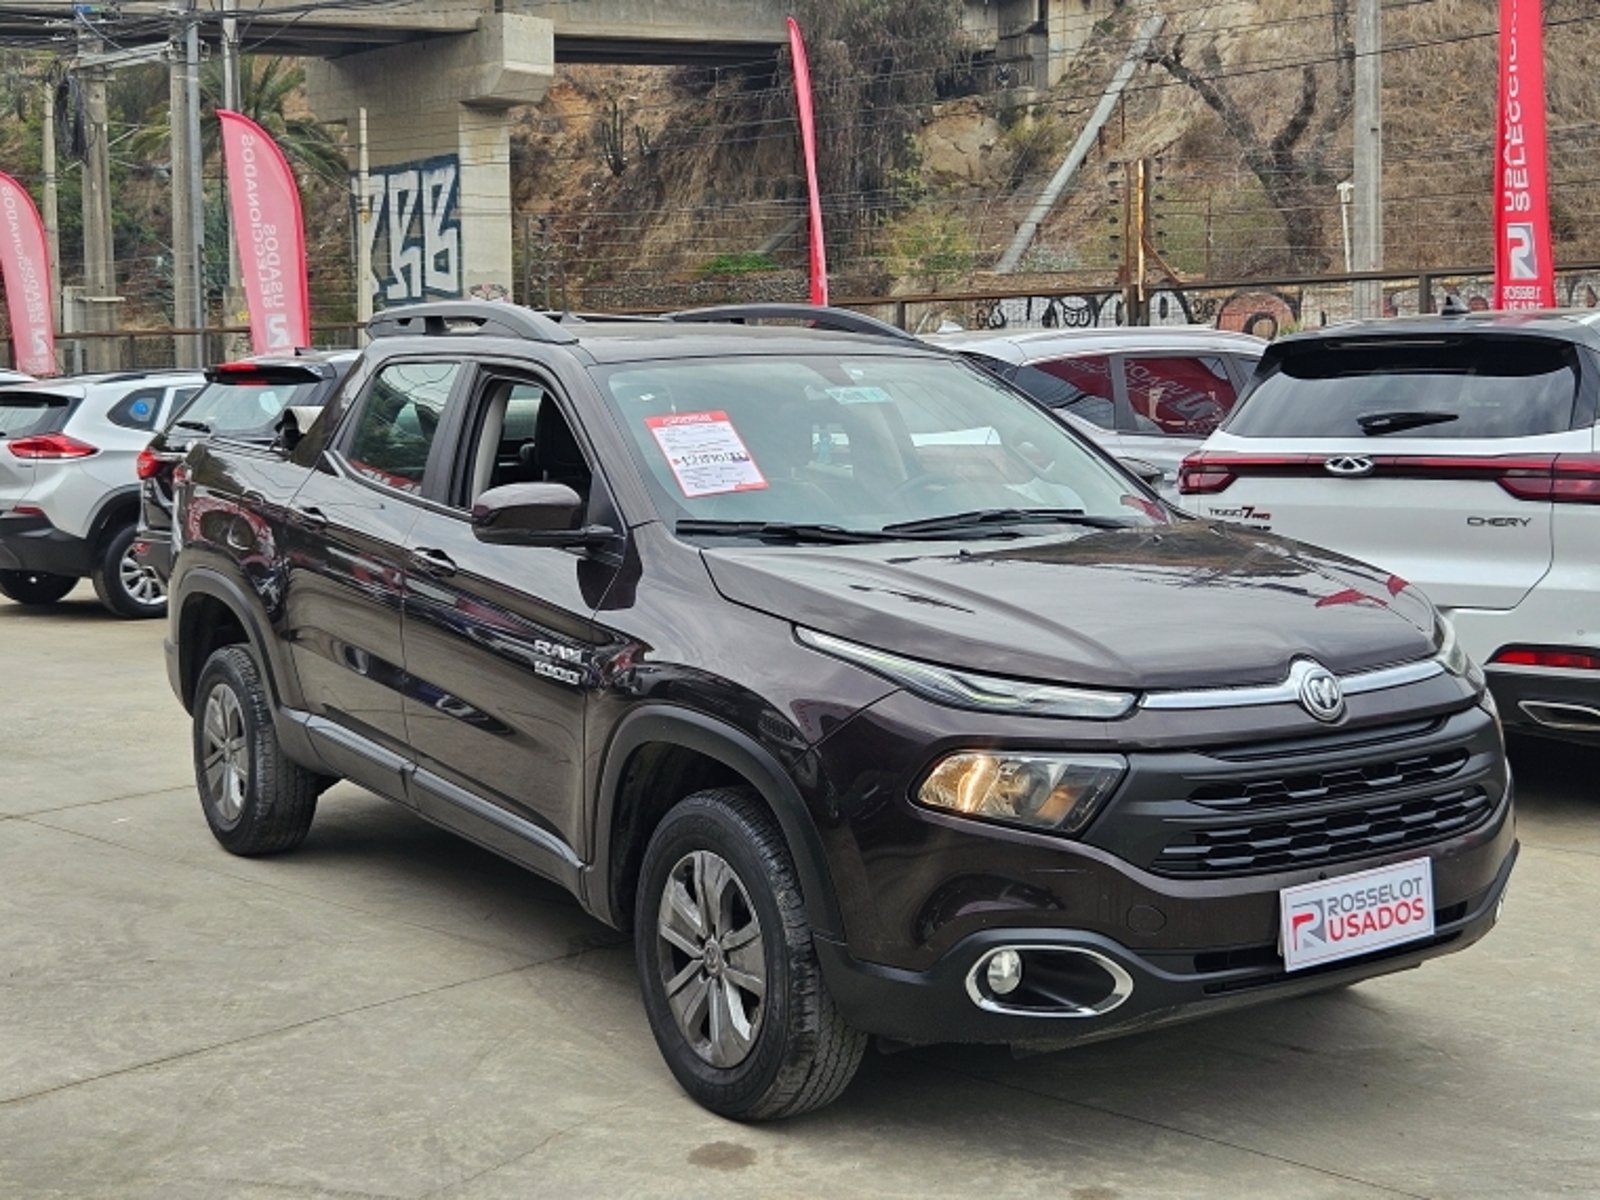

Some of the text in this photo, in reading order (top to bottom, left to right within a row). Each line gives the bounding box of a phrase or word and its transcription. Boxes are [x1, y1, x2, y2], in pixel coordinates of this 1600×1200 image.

[1467, 517, 1532, 528] CHERY
[534, 640, 582, 663] RAM
[1327, 877, 1423, 917] ROSSELOT
[1328, 897, 1425, 942] USADOS
